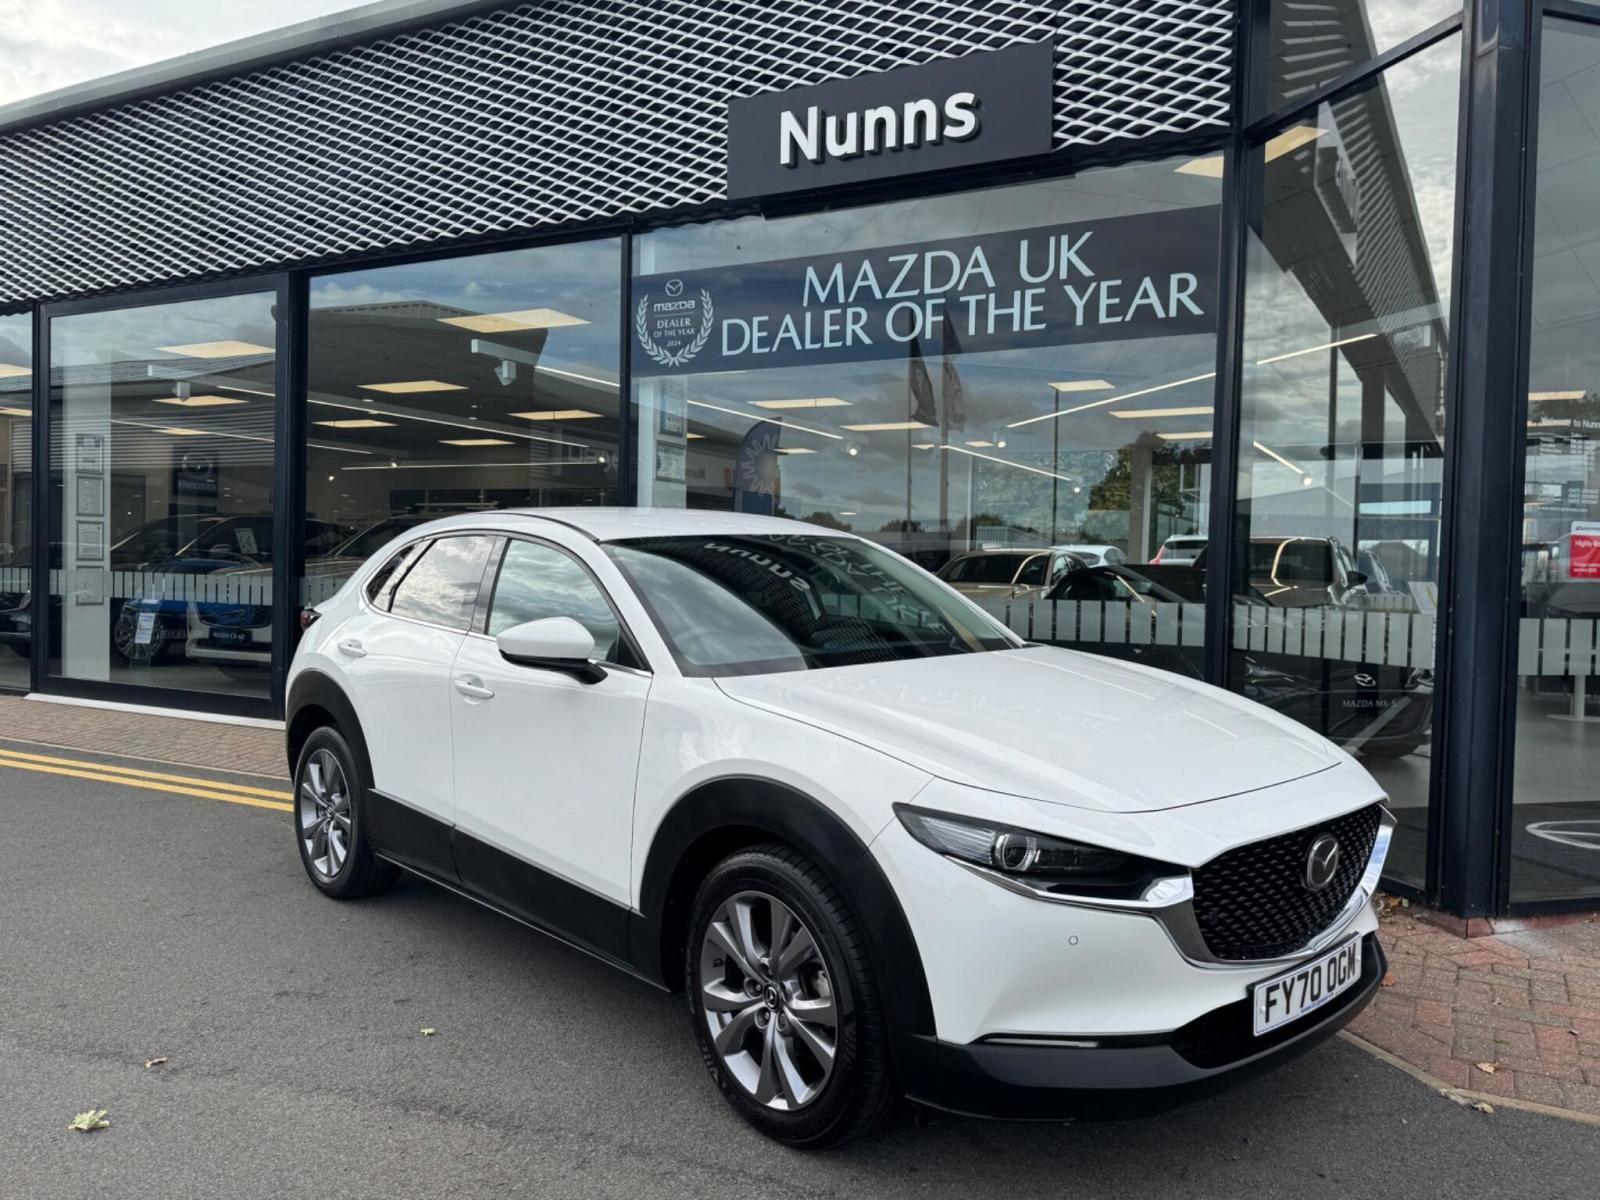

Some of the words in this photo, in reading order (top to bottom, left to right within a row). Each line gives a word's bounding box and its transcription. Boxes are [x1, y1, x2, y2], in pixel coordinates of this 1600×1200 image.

[780, 92, 977, 166] Nunns
[803, 246, 995, 306] MAZDA
[1019, 231, 1095, 283] UK
[653, 330, 662, 338] OF
[664, 329, 676, 337] THE
[679, 327, 695, 336] YEAR
[657, 318, 691, 329] DEALER
[722, 306, 873, 356] DEALER
[885, 298, 946, 342] OF
[959, 287, 1047, 336] THE
[1063, 272, 1204, 326] YEAR
[1342, 699, 1374, 708] MAZDA
[1265, 965, 1322, 1023] FY70
